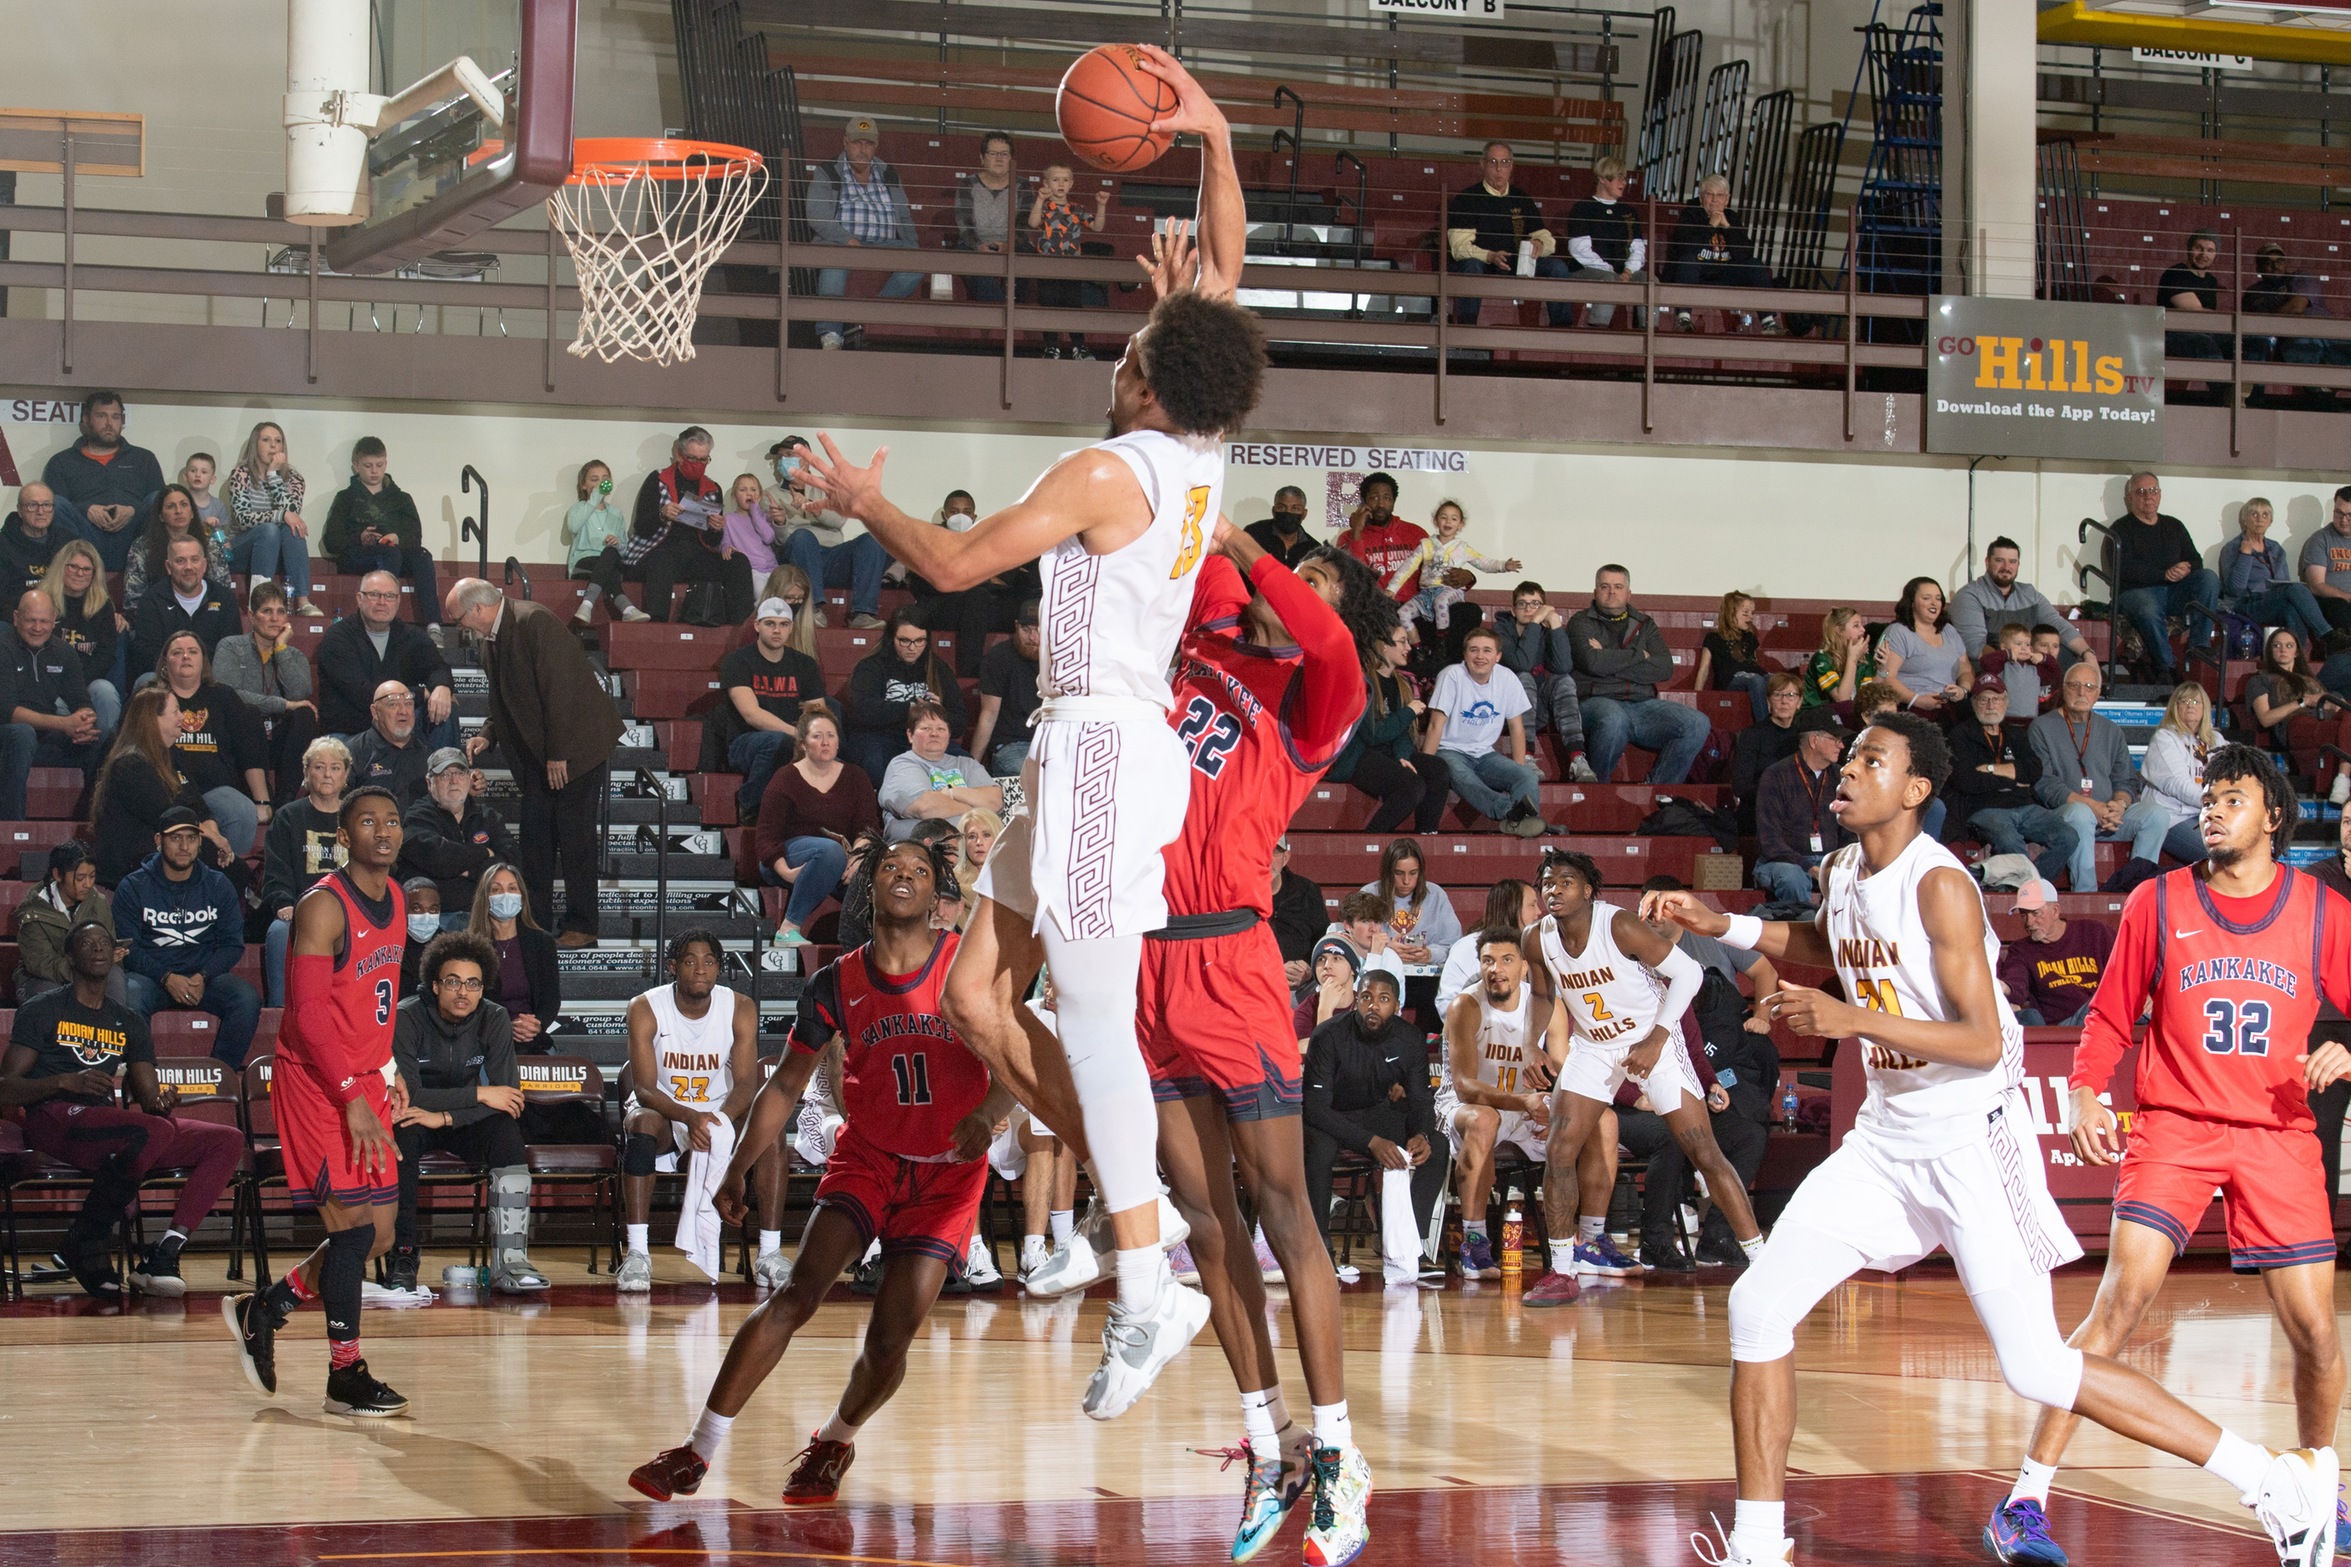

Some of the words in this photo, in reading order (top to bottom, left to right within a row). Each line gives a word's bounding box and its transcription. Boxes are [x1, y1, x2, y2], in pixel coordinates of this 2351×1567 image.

[1975, 336, 2124, 395] Hills
[12, 400, 80, 423] SEAT
[1937, 400, 2022, 416] Download
[2028, 403, 2055, 417] the
[2061, 405, 2093, 421] App
[2100, 407, 2156, 424] Today!
[1231, 445, 1355, 468] RESERVED
[1368, 449, 1465, 471] SEATING
[1177, 694, 1243, 781] 22
[143, 905, 218, 926] Reebok
[356, 944, 404, 980] KANKAK
[592, 952, 624, 960] people
[1838, 938, 1899, 968] INDIAN
[1560, 966, 1615, 989] INDIAN
[2066, 957, 2098, 975] HILLS
[2180, 957, 2297, 999] KANKAKEE
[375, 978, 393, 1026] 3
[1583, 991, 1614, 1021] 2
[57, 1020, 95, 1040] INDIAN
[97, 1028, 127, 1047] HILLS
[861, 1013, 954, 1047] KANKAKEE
[1589, 1017, 1637, 1041] HILLS
[2203, 997, 2271, 1057] 32
[663, 1051, 719, 1070] INDIAN
[1485, 1043, 1523, 1062] IDIA
[155, 1068, 185, 1083] DIAN
[186, 1069, 222, 1084] HILLS
[518, 1065, 549, 1081] DIAN
[552, 1066, 587, 1081] HILLS
[891, 1052, 933, 1106] 11
[2116, 1112, 2134, 1133] T
